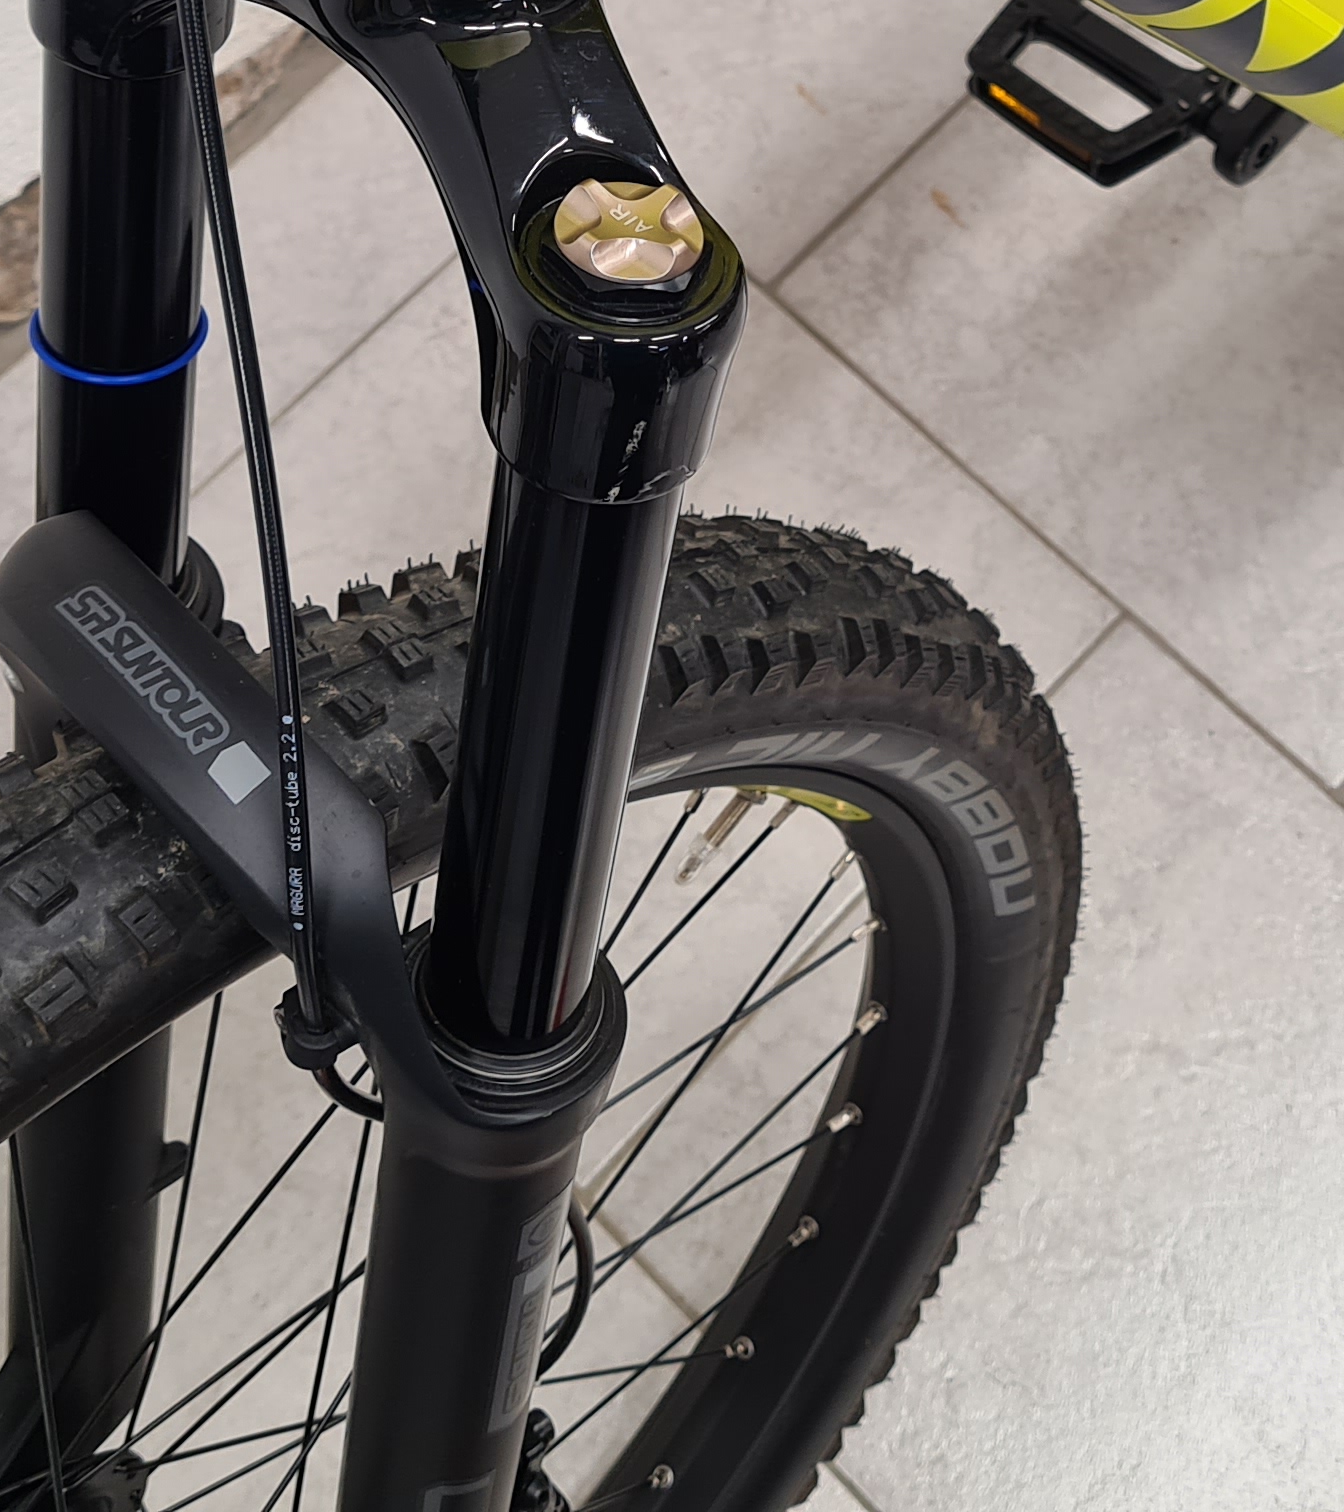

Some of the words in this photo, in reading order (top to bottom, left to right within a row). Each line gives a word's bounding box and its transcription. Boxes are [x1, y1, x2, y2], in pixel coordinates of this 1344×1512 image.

[609, 203, 654, 233] AIR
[281, 730, 299, 764] 2.2
[286, 771, 303, 852] disc-tube
[870, 746, 1036, 918] NOBBY
[289, 867, 304, 916] MAGURA
